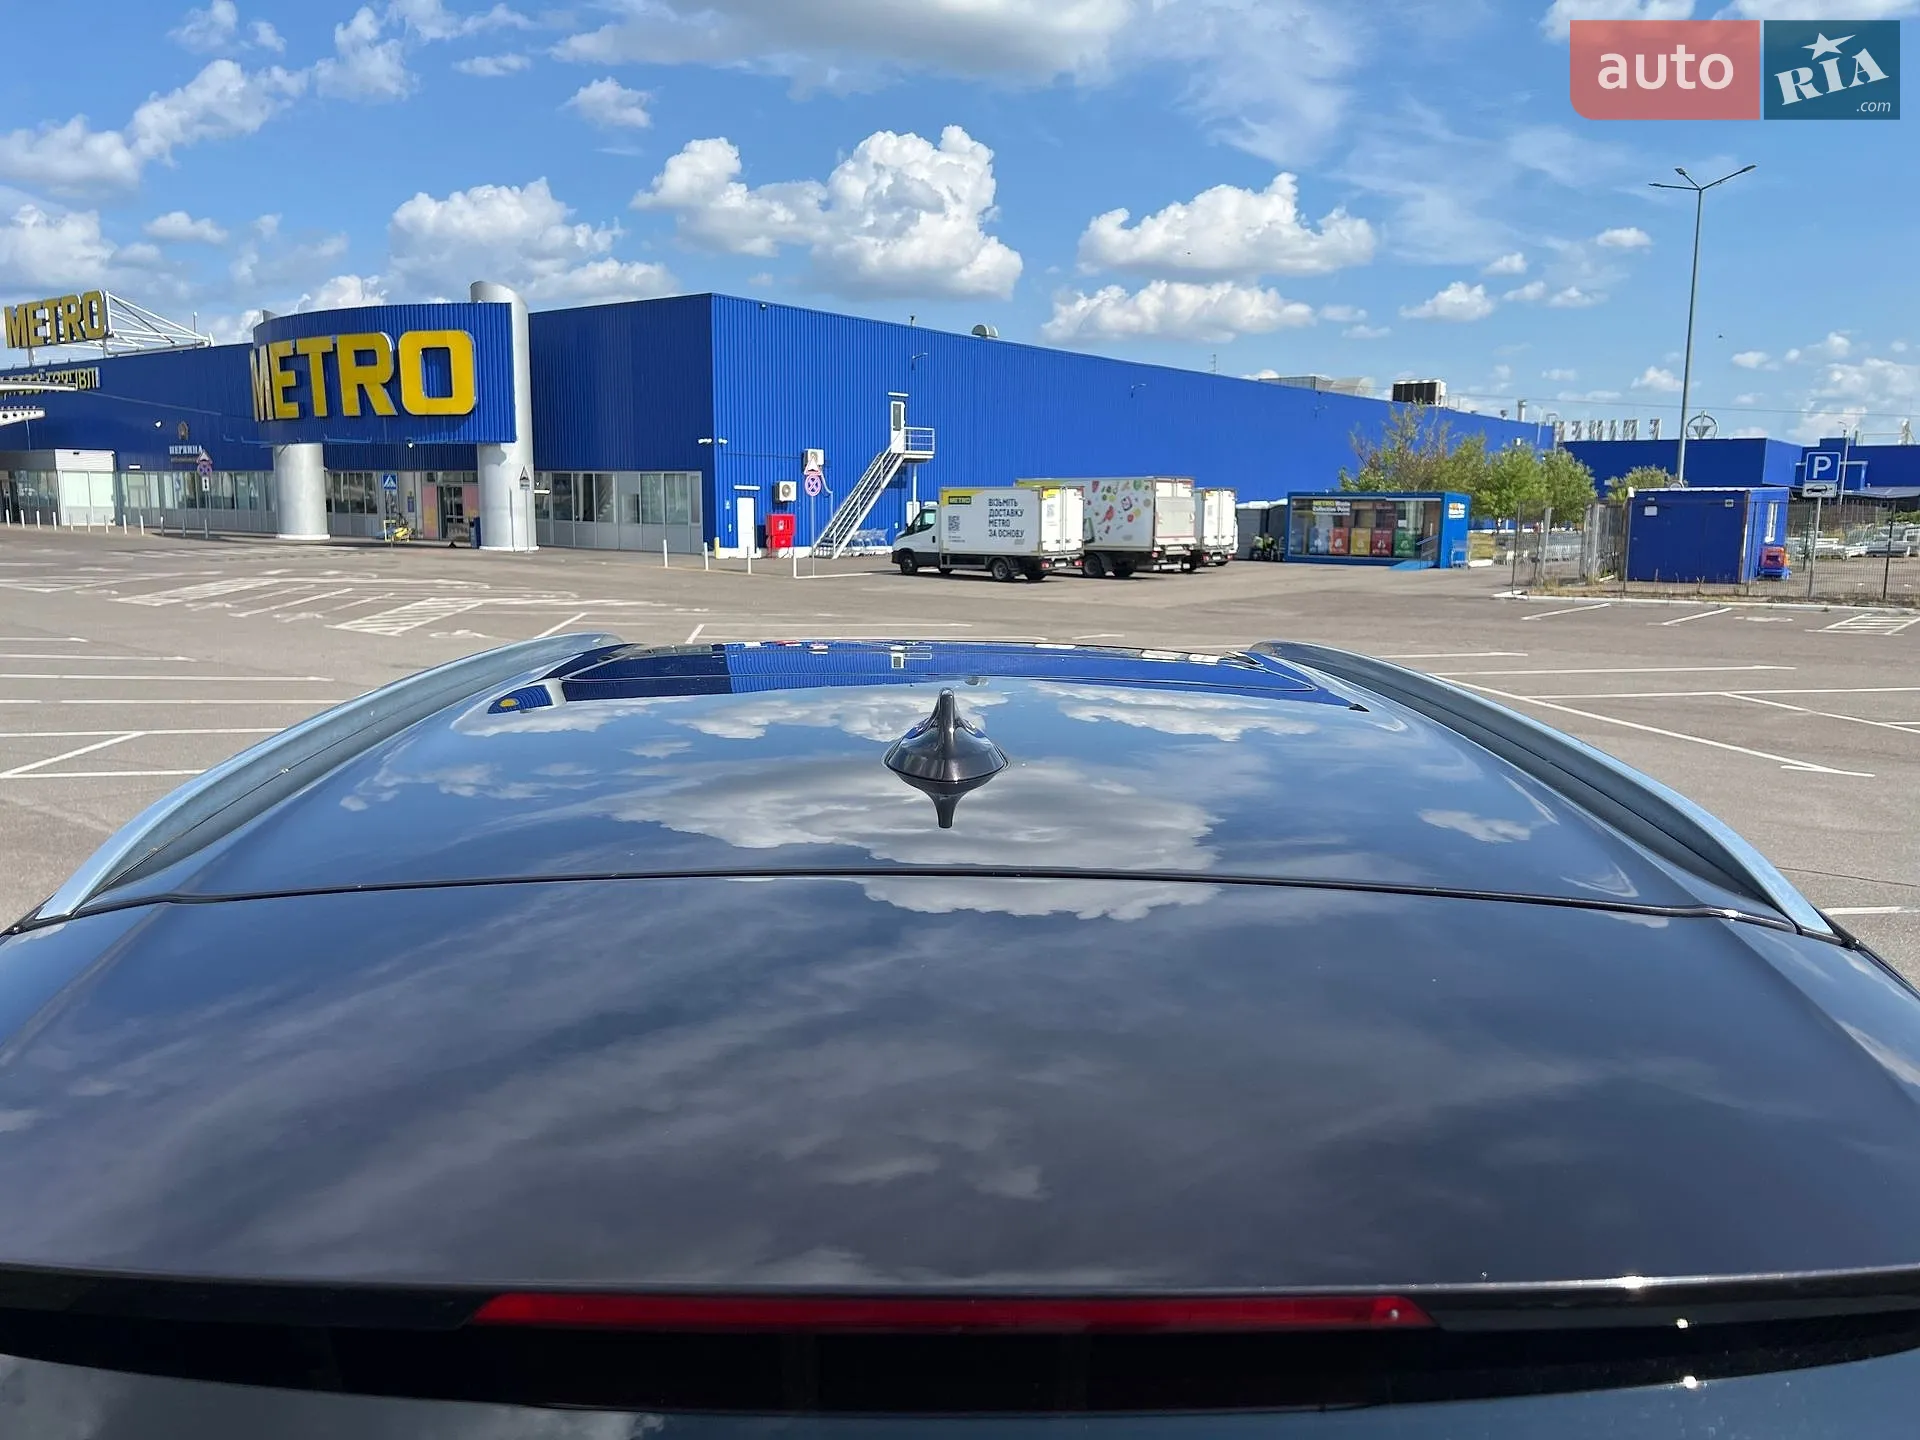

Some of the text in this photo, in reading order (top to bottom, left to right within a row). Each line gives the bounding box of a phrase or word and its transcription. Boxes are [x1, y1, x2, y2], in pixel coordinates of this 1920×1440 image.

[4, 289, 107, 348] METRO
[249, 329, 477, 422] METRO
[1812, 455, 1832, 479] P
[949, 496, 971, 504] METRO
[988, 498, 1019, 507] ВІЗЬМІТЬ
[988, 508, 1025, 518] ДОСТАВКУ
[988, 519, 1011, 528] METRO
[988, 529, 1025, 538] ЗА ОСНОВУ
